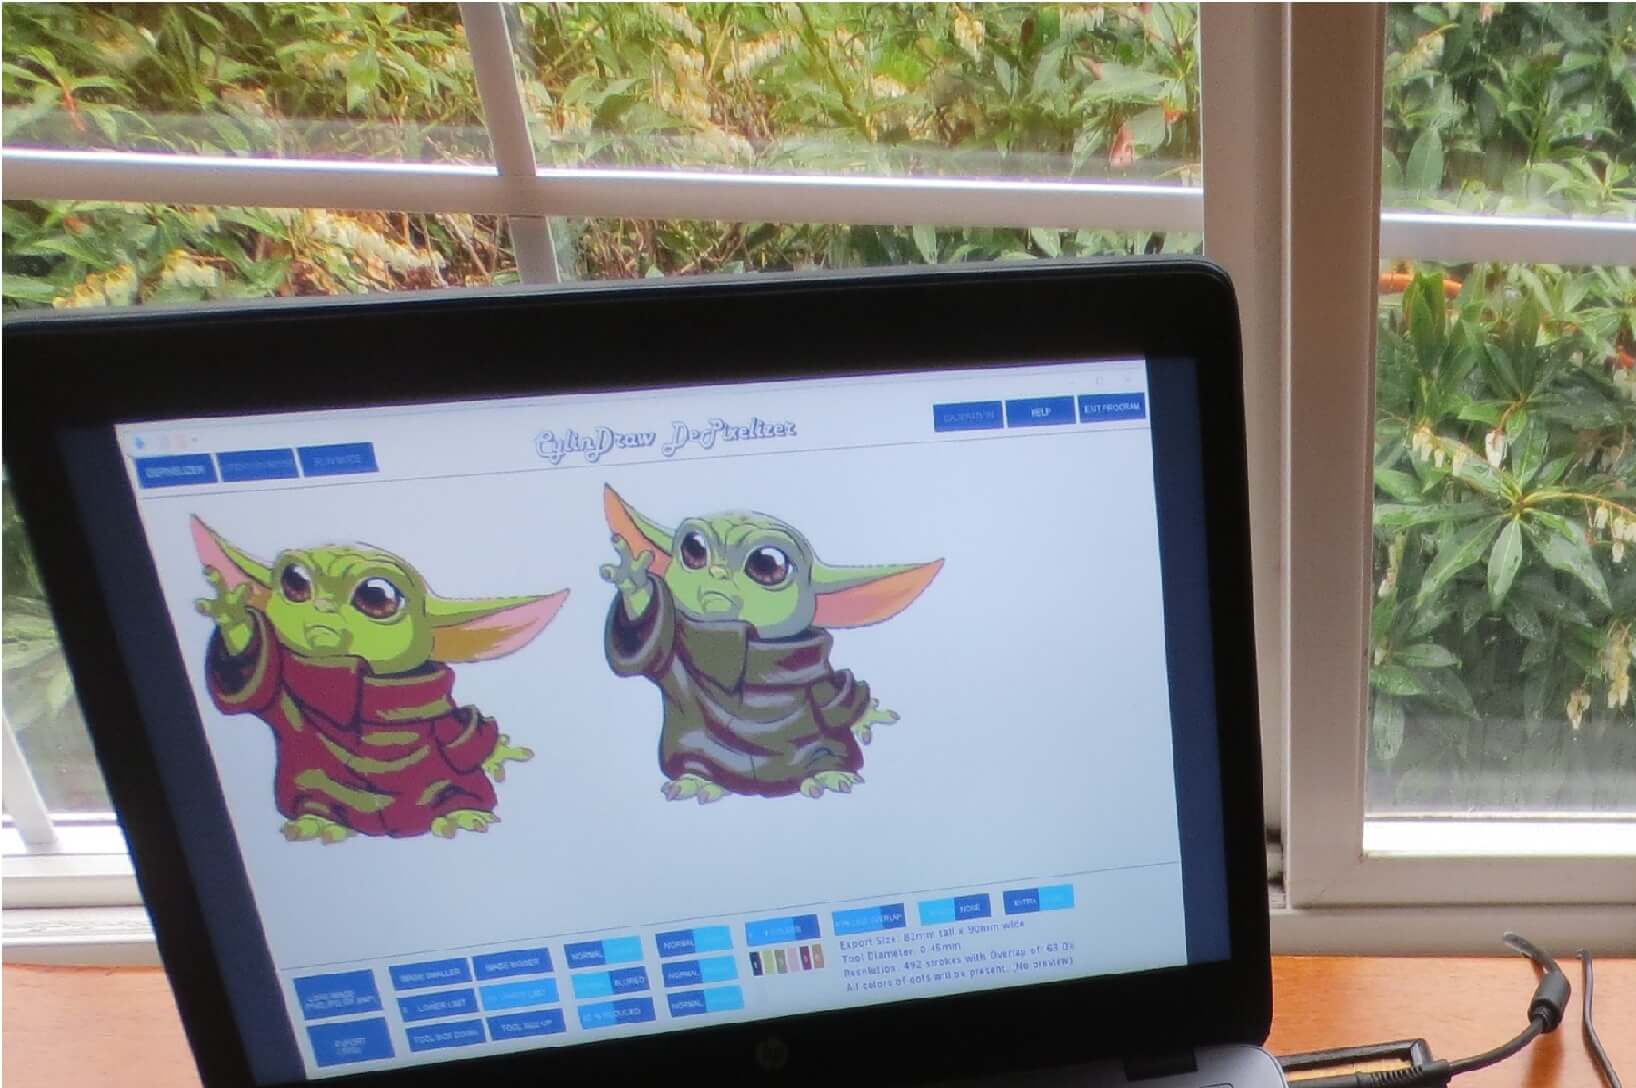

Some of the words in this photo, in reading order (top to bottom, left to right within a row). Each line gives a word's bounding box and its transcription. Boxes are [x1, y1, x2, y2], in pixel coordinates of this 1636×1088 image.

[1030, 407, 1051, 418] HELP
[534, 426, 657, 465] CylinDraw
[663, 939, 695, 951] NORMAL
[839, 937, 874, 951] Export
[841, 951, 865, 963] Tool
